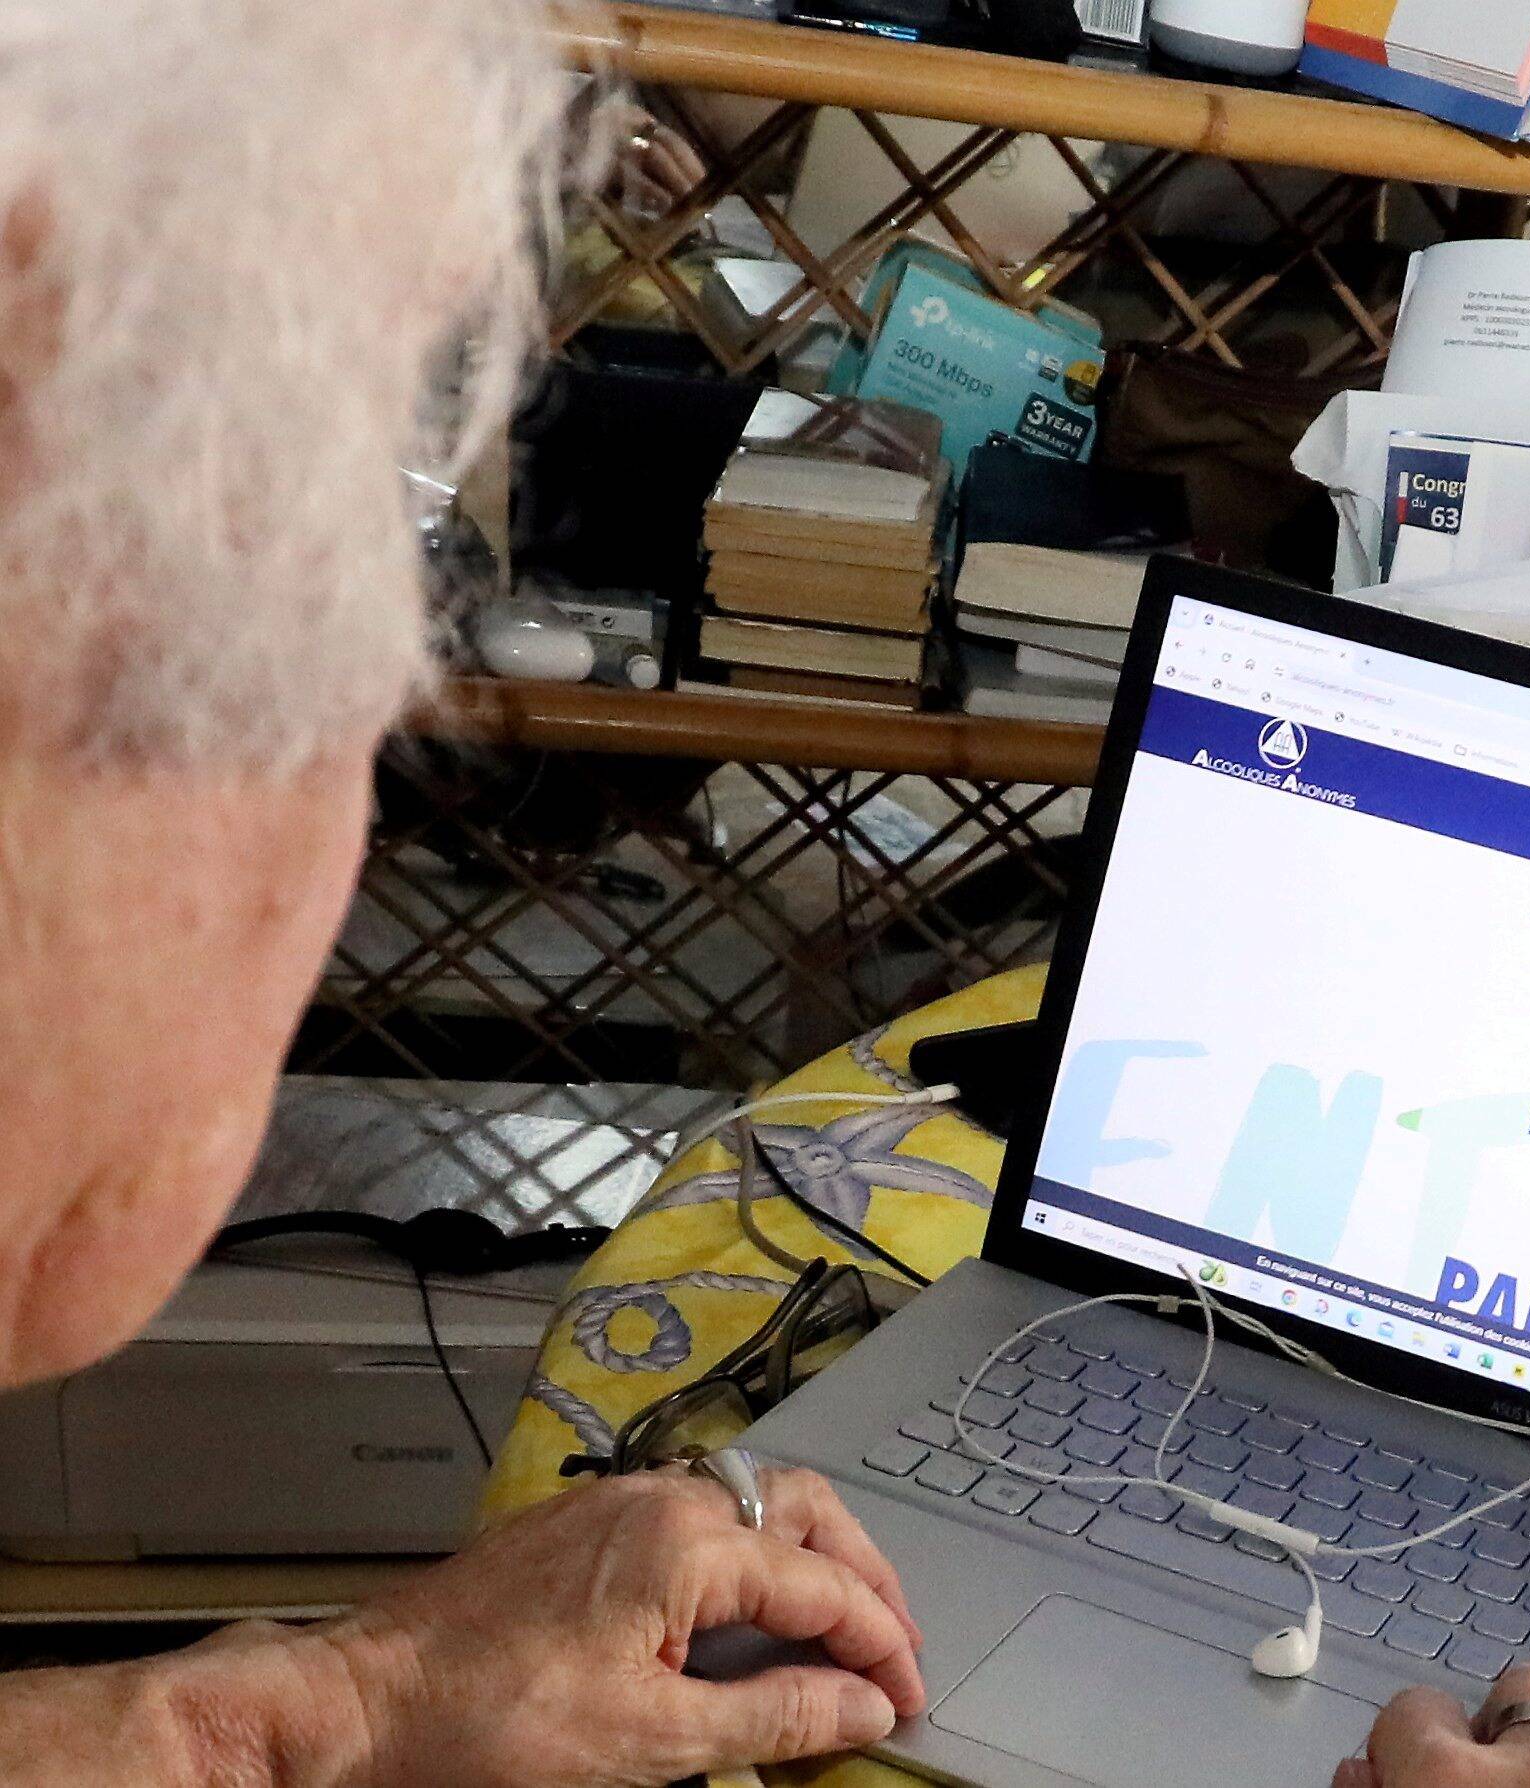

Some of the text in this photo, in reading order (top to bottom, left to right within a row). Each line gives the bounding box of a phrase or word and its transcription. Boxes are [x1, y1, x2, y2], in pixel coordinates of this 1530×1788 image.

[893, 338, 936, 370] 300
[936, 357, 994, 399] Mbps
[1026, 399, 1084, 439] 3 YEAR
[1412, 473, 1466, 498] Congr
[1411, 496, 1427, 508] du
[1430, 506, 1460, 529] 63
[350, 1442, 455, 1463] Canon
